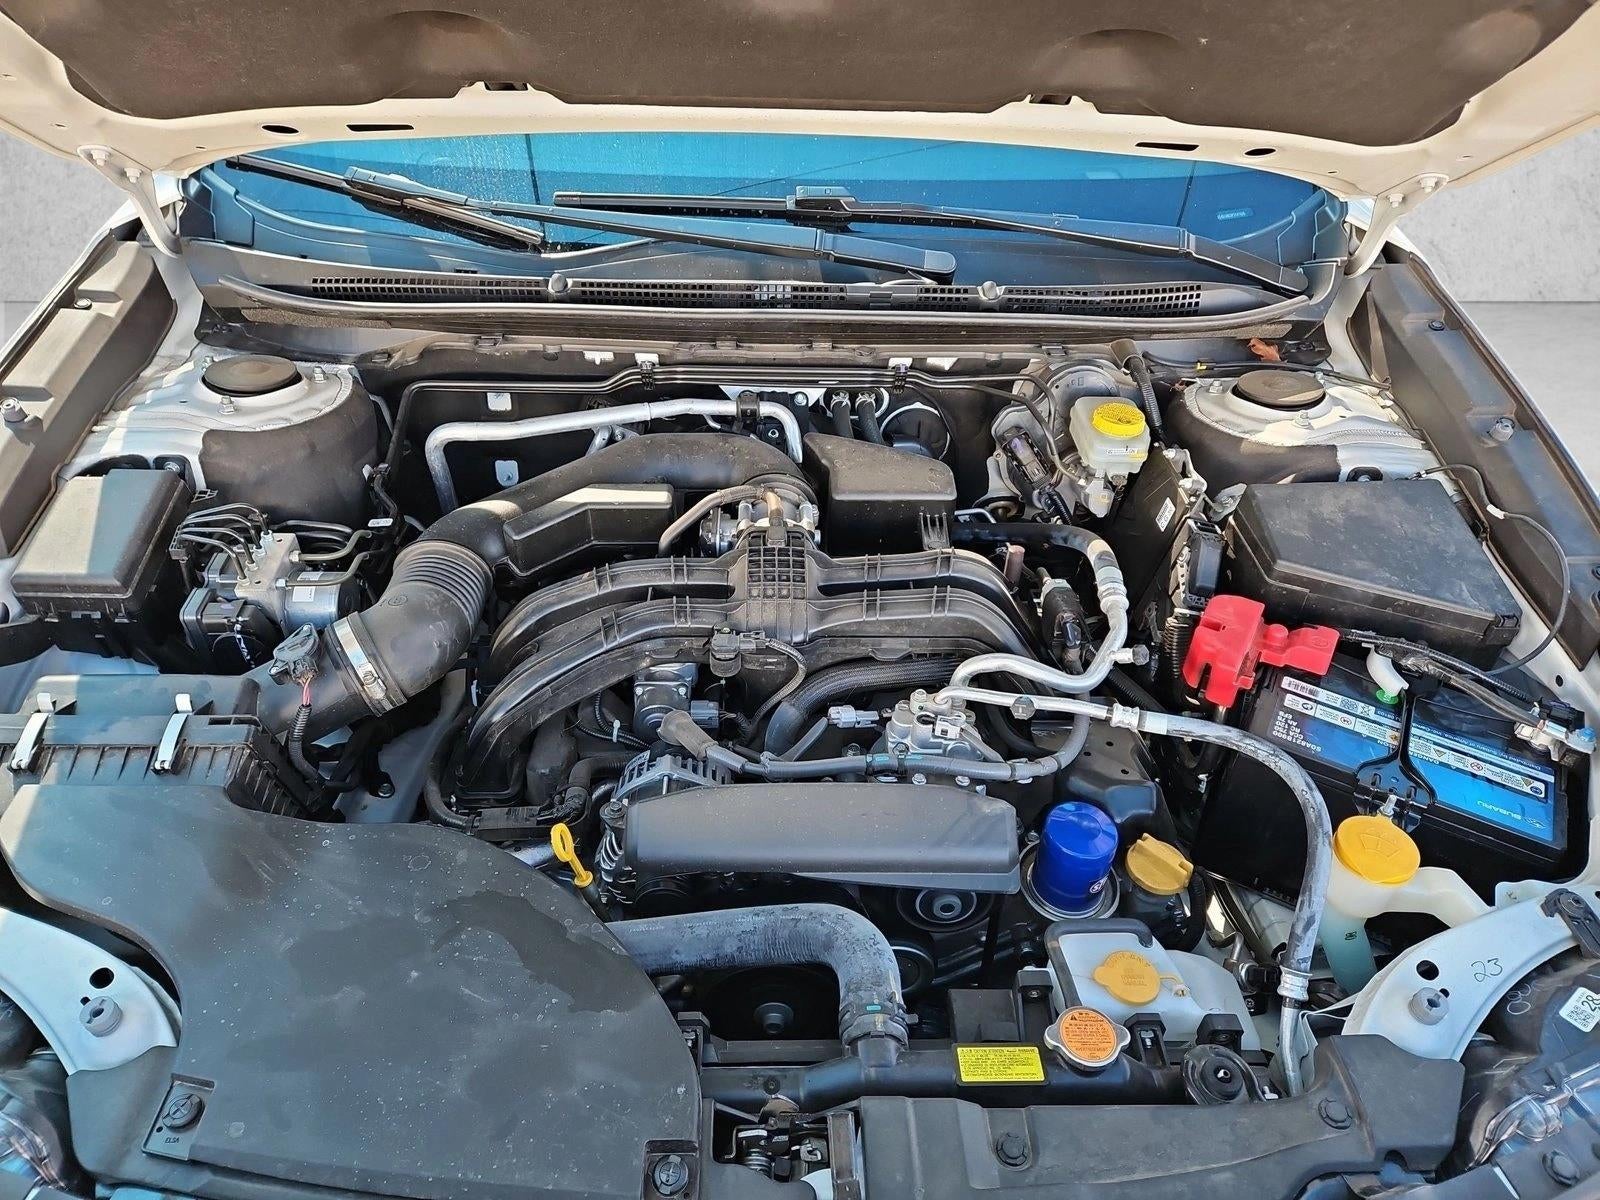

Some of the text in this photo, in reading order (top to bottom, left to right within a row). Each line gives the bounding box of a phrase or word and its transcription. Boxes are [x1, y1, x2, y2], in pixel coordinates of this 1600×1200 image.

[1288, 730, 1304, 739] CCA
[1477, 800, 1521, 819] SUBARU
[1470, 958, 1503, 983] 23
